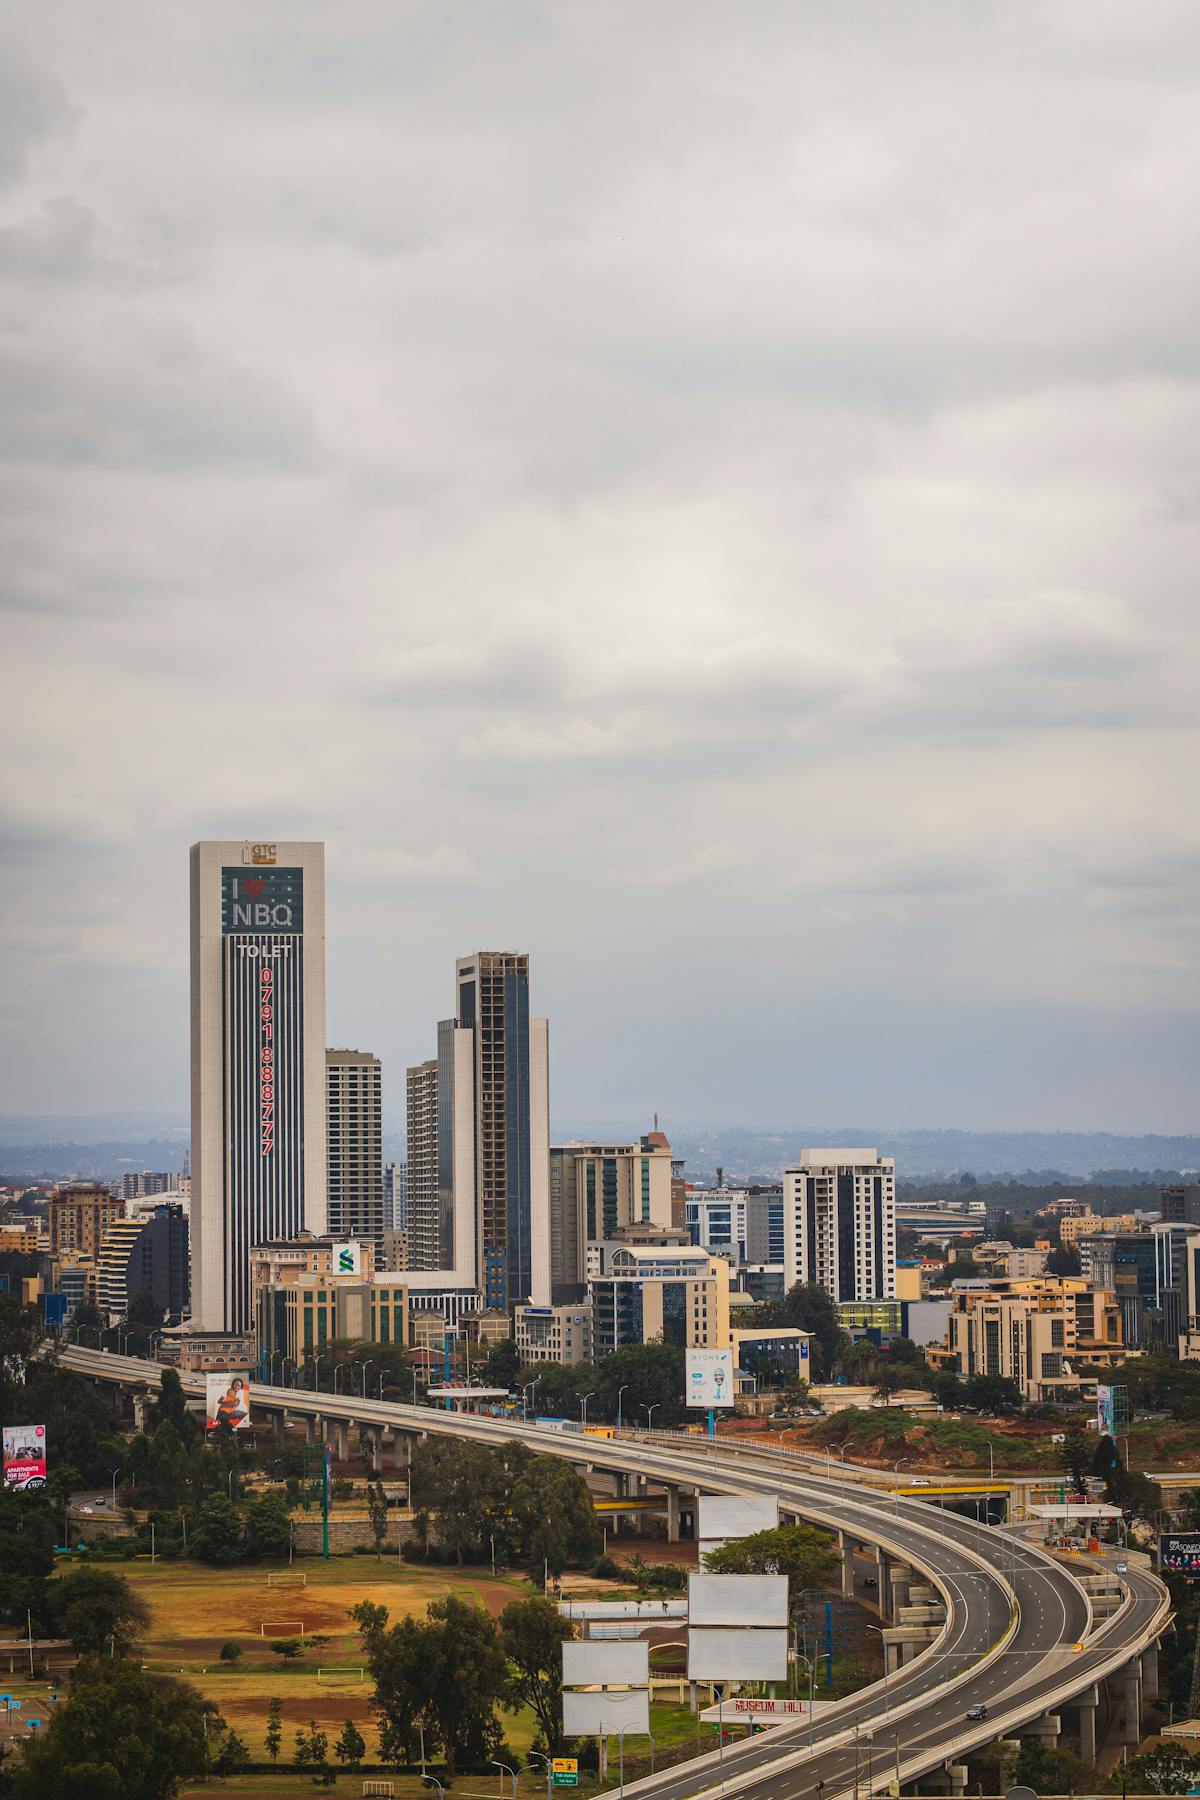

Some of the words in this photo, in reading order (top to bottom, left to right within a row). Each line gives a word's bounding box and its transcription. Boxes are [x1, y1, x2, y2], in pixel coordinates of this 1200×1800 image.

[252, 844, 277, 855] GTC
[232, 878, 239, 899] I
[237, 945, 260, 958] TO
[261, 945, 292, 958] LET
[7, 1465, 39, 1474] APARTMENTS
[735, 1700, 775, 1713] MUSEUM
[783, 1701, 806, 1713] HILL
